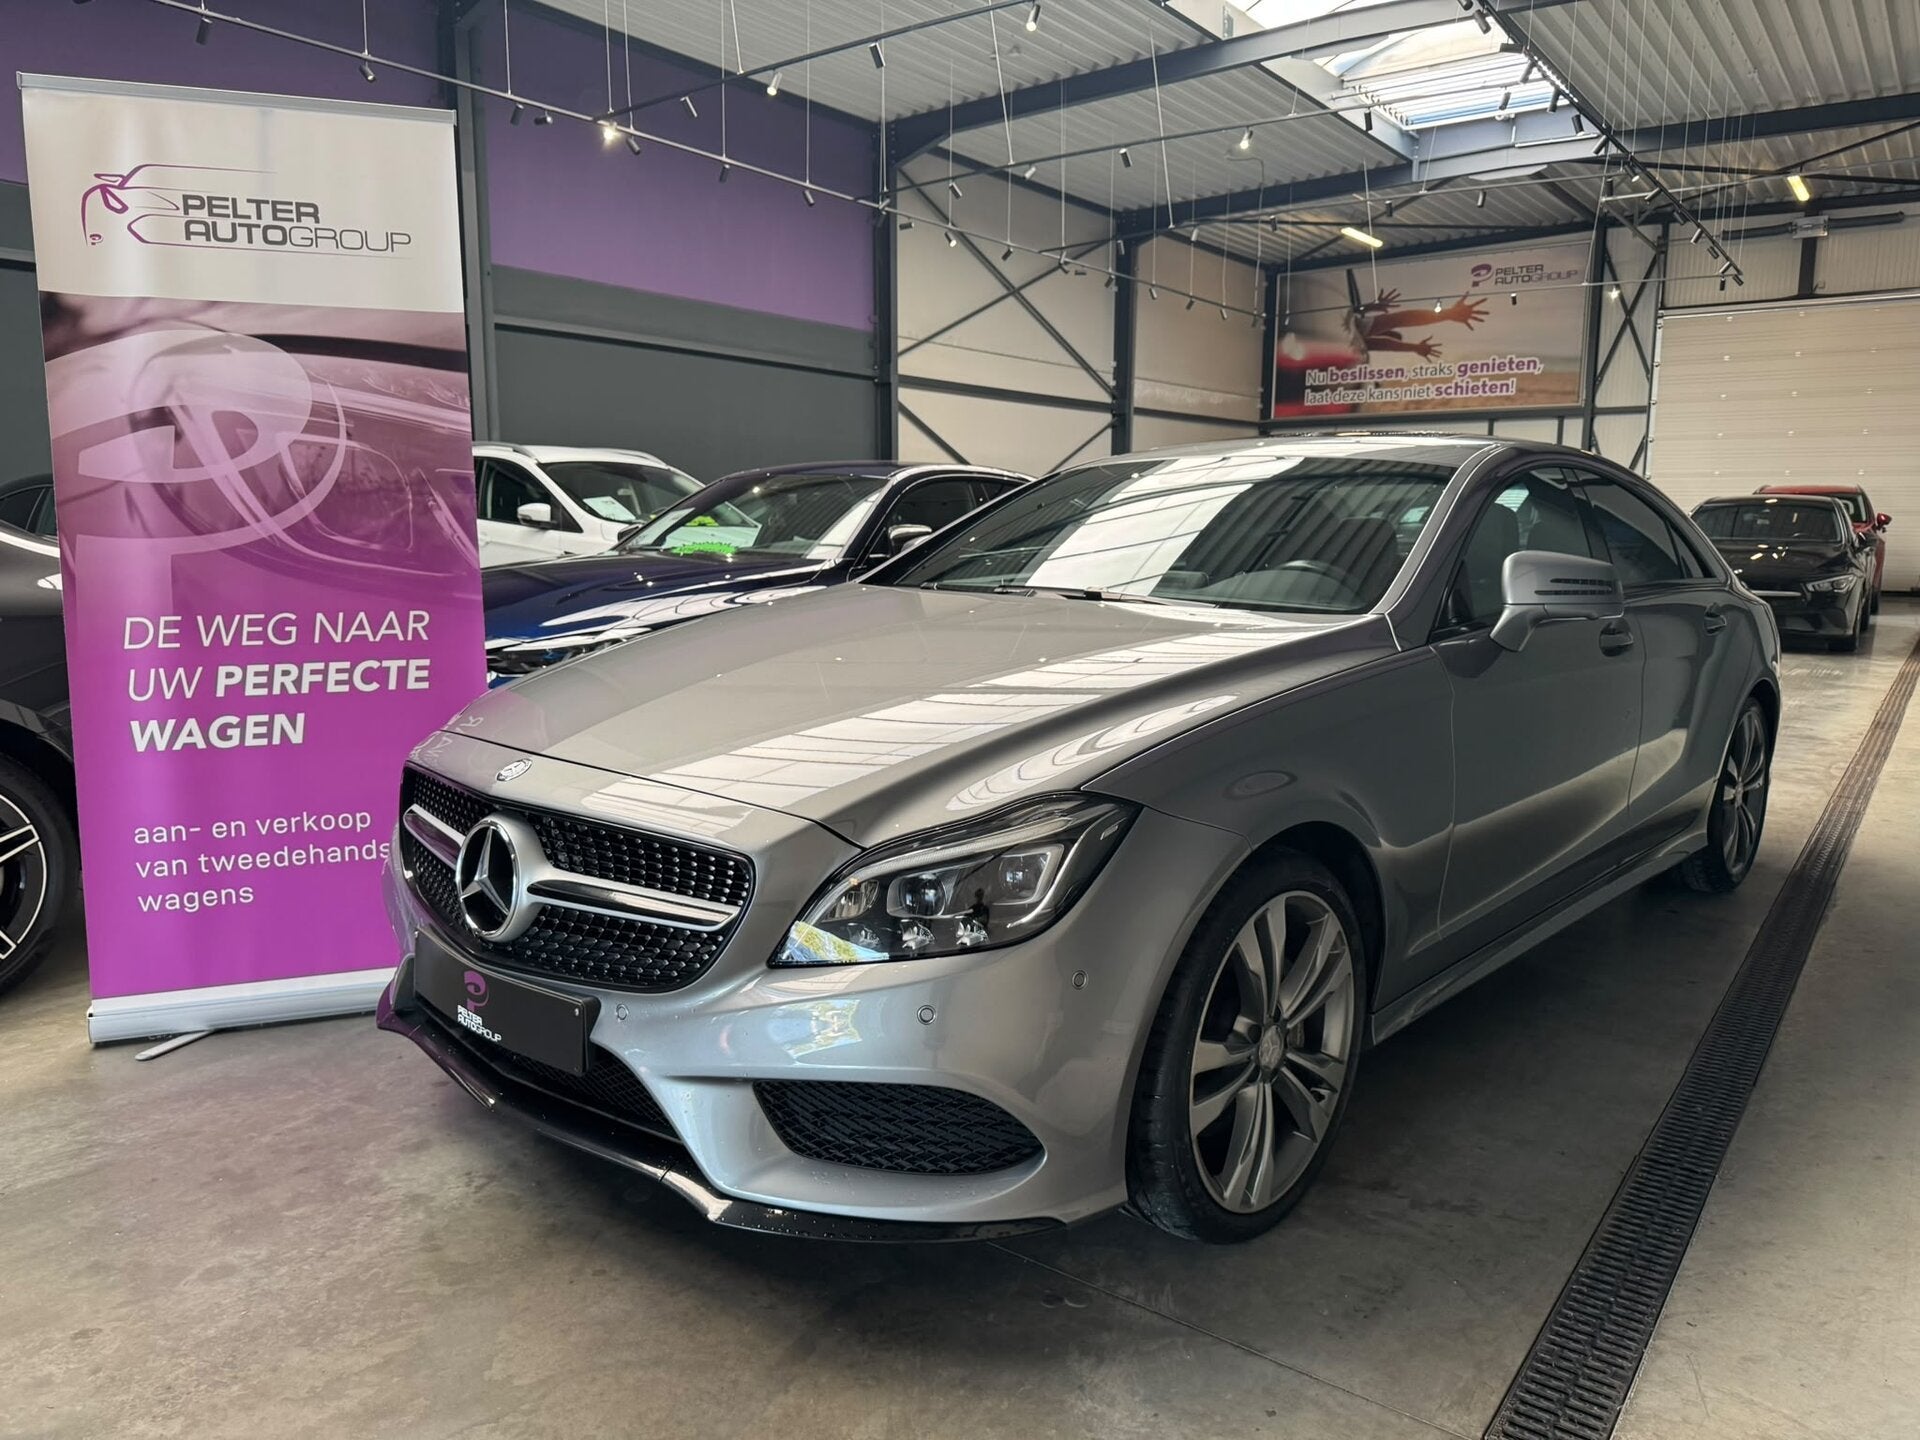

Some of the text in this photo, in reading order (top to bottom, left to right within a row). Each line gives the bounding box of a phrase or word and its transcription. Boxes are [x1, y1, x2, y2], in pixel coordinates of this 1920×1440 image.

[182, 194, 320, 224] PELTER
[184, 219, 412, 253] AUTOGROUP
[1494, 269, 1578, 285] AUTOGROUP
[1495, 264, 1544, 276] PELTER
[1306, 357, 1544, 385] Nu beslissen, straks genieten,
[1305, 380, 1515, 404] laat deze kans niet schieten!
[123, 610, 430, 650] DE WEG NAAR
[128, 659, 430, 701] UW PERFECTE
[130, 713, 305, 752] WAGEN
[134, 811, 372, 844] aan- en verkoop
[135, 839, 391, 878] van tweedehands
[138, 886, 254, 913] wagens
[457, 1004, 483, 1026] PELTER
[457, 1014, 502, 1043] AUTOGROUP
